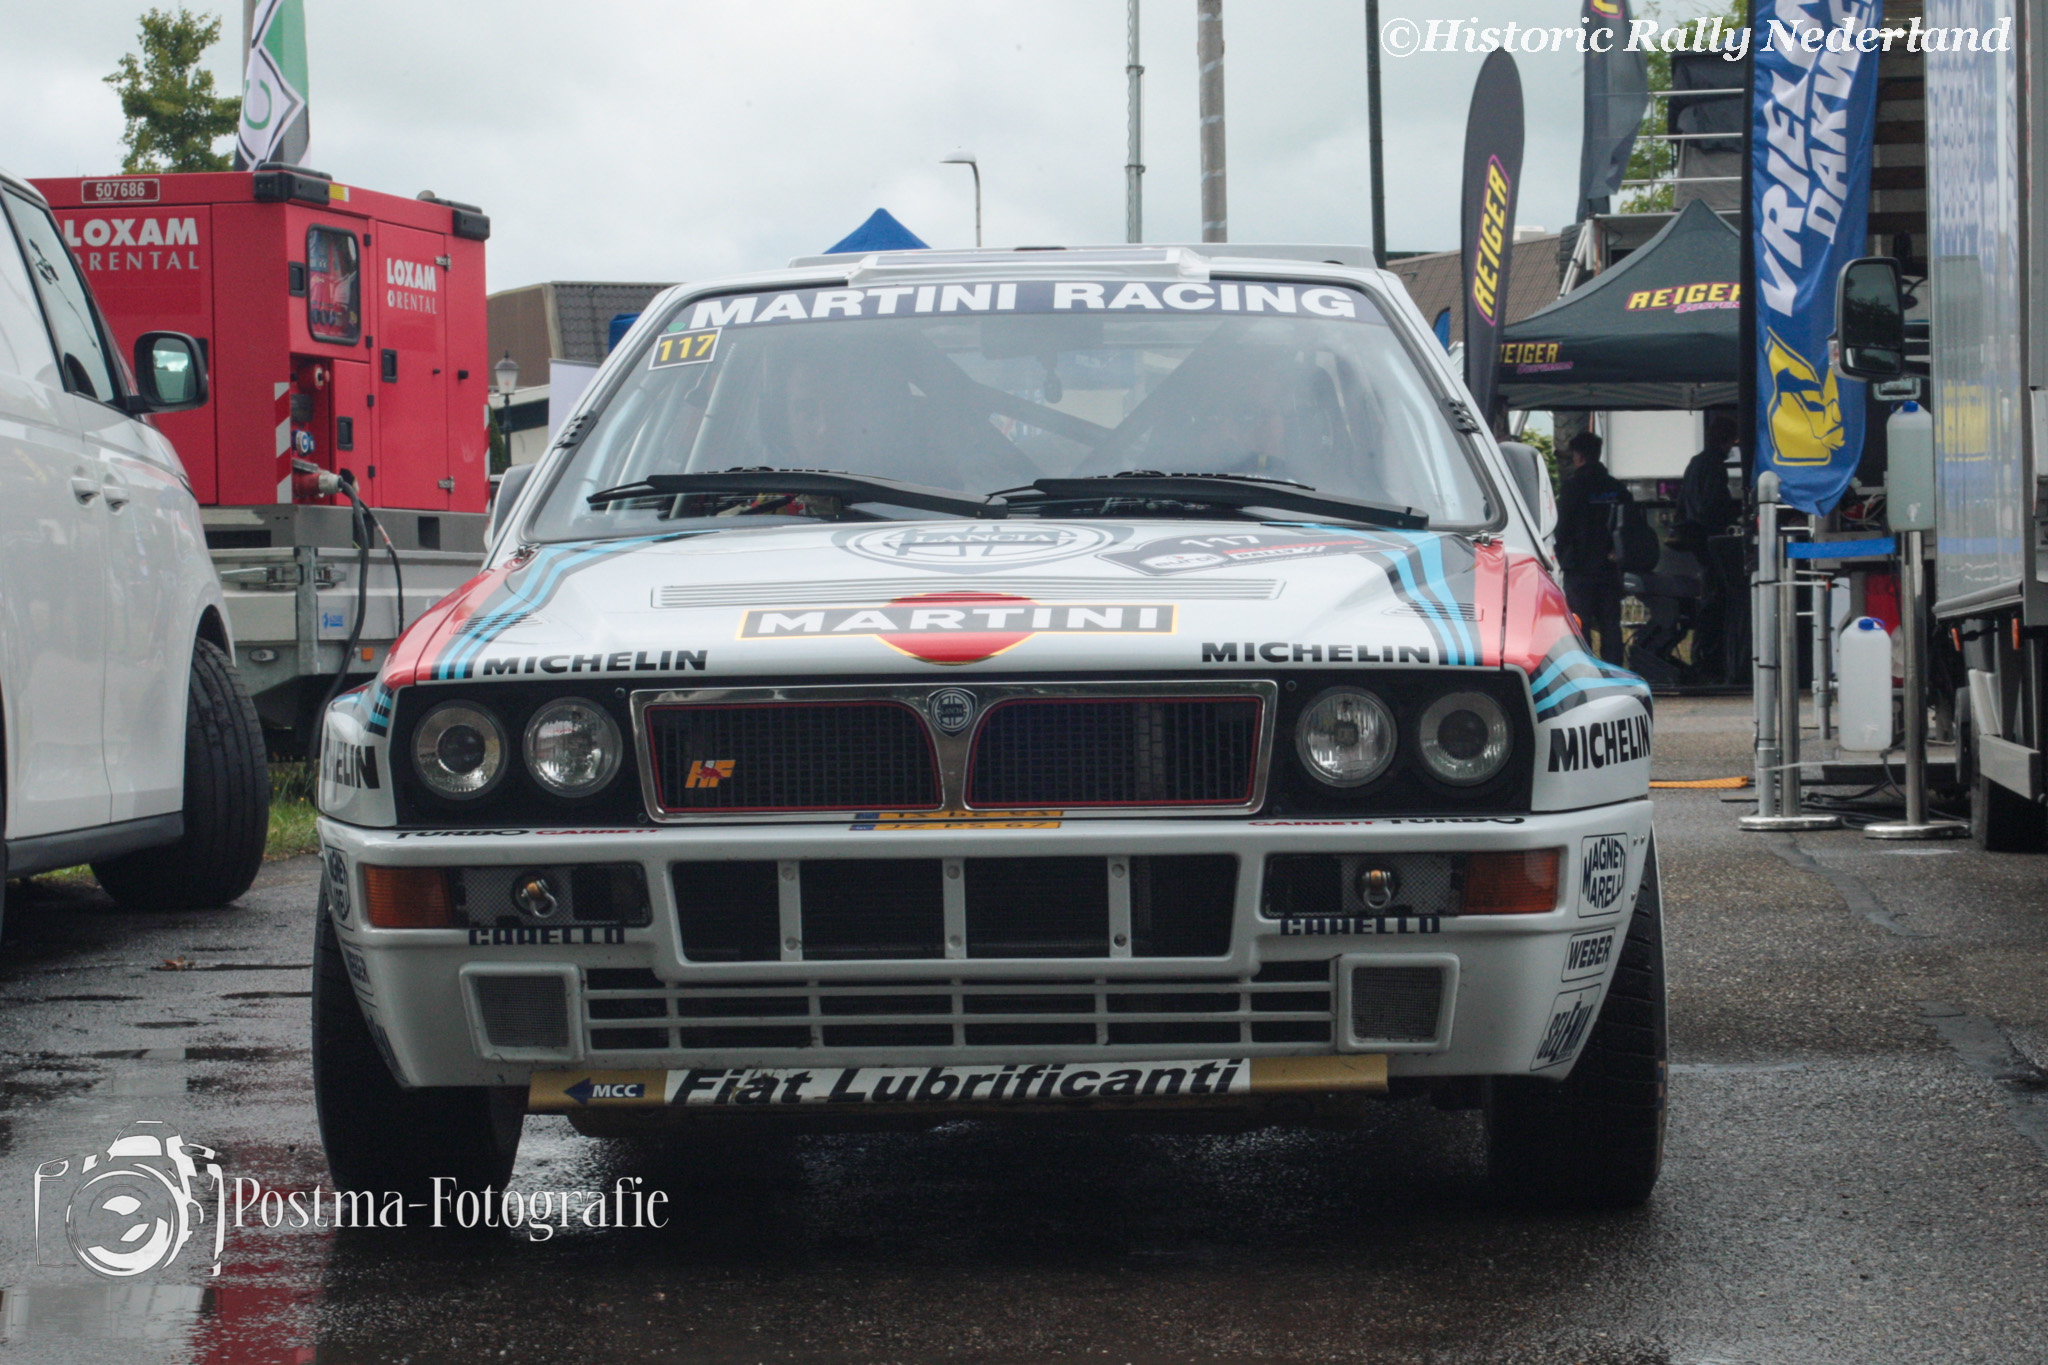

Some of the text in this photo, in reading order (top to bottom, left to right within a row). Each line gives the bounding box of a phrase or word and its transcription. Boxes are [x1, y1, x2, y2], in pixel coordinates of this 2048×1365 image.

[1805, 0, 1872, 245] DAKWE
[95, 181, 146, 198] 507686
[63, 217, 199, 247] LOXAM
[1473, 164, 1509, 318] REIGER
[386, 257, 437, 292] LOXAM
[688, 282, 1356, 330] MARTINI RACING
[658, 334, 718, 363] 117
[1500, 343, 1559, 364] EIGER
[915, 532, 1053, 544] LANCIA
[1179, 535, 1261, 549] 117
[757, 606, 1159, 635] MARTINI
[482, 650, 708, 676] MICHELIN
[1201, 641, 1430, 664] MICHELIN
[1547, 713, 1651, 773] MICHELIN
[396, 829, 530, 840] TURBO
[1382, 816, 1525, 825] TURBO
[1567, 934, 1613, 970] WEBER
[592, 1083, 639, 1098] MCC
[670, 1058, 1245, 1106] Fiat Lubrificanti
